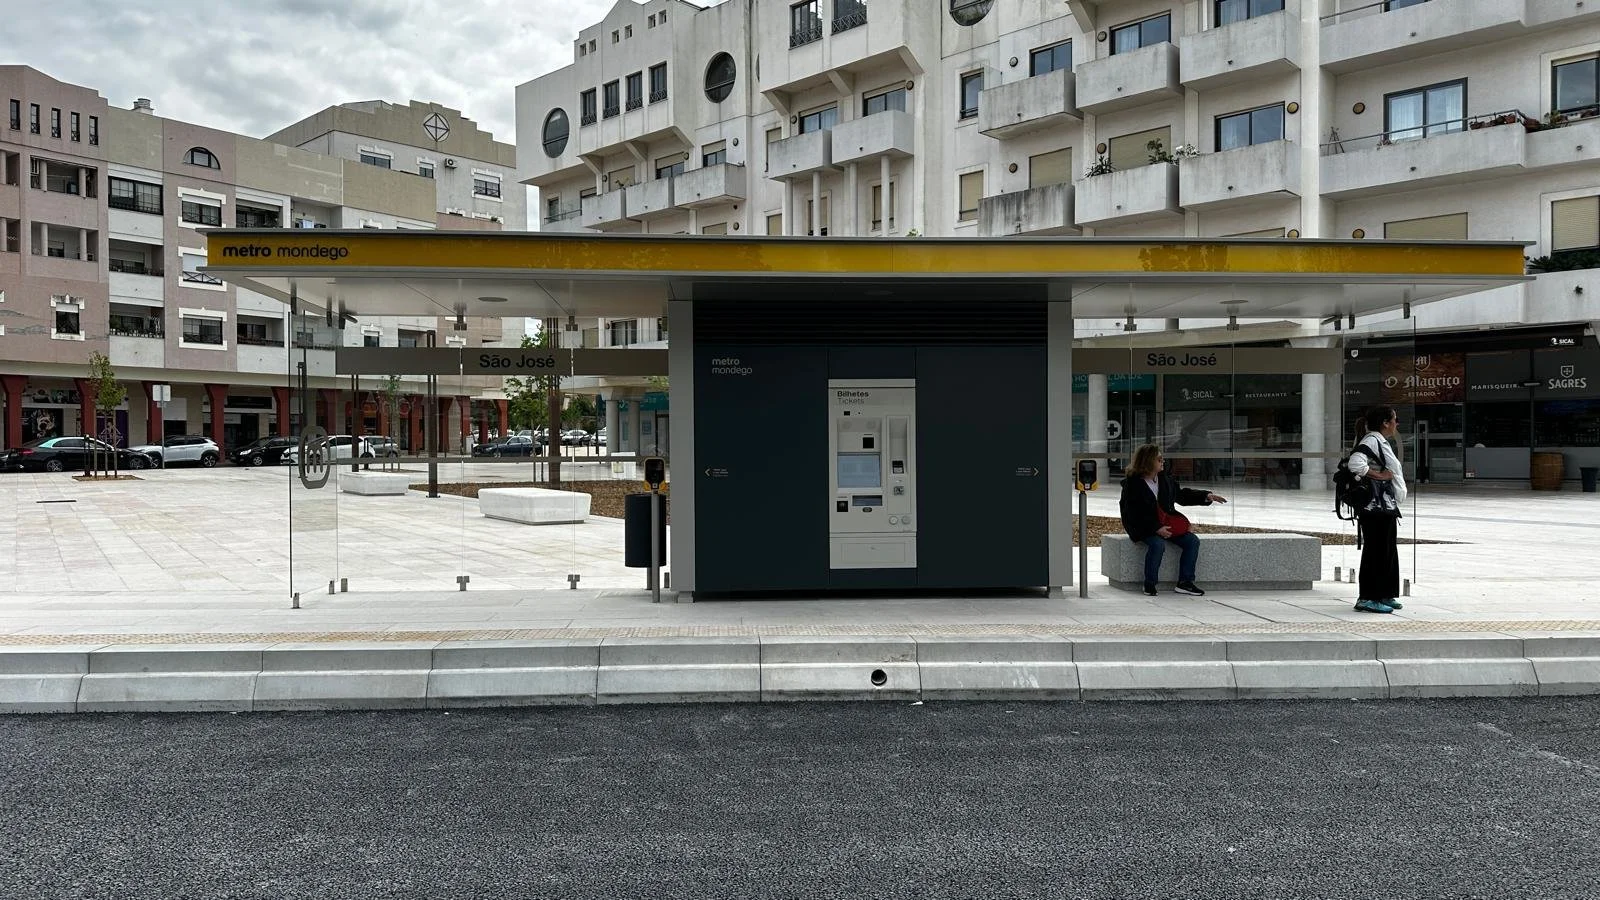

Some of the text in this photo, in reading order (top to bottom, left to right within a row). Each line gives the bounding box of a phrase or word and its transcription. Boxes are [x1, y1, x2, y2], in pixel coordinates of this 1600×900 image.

[223, 244, 349, 260] metro mondego
[479, 354, 555, 368] São José
[712, 357, 740, 365] metro
[1147, 353, 1217, 366] São José
[712, 366, 753, 376] mondego
[1385, 374, 1460, 389] O Magriço
[1471, 383, 1520, 391] MARISQUEIR
[1548, 378, 1587, 390] SAGRES
